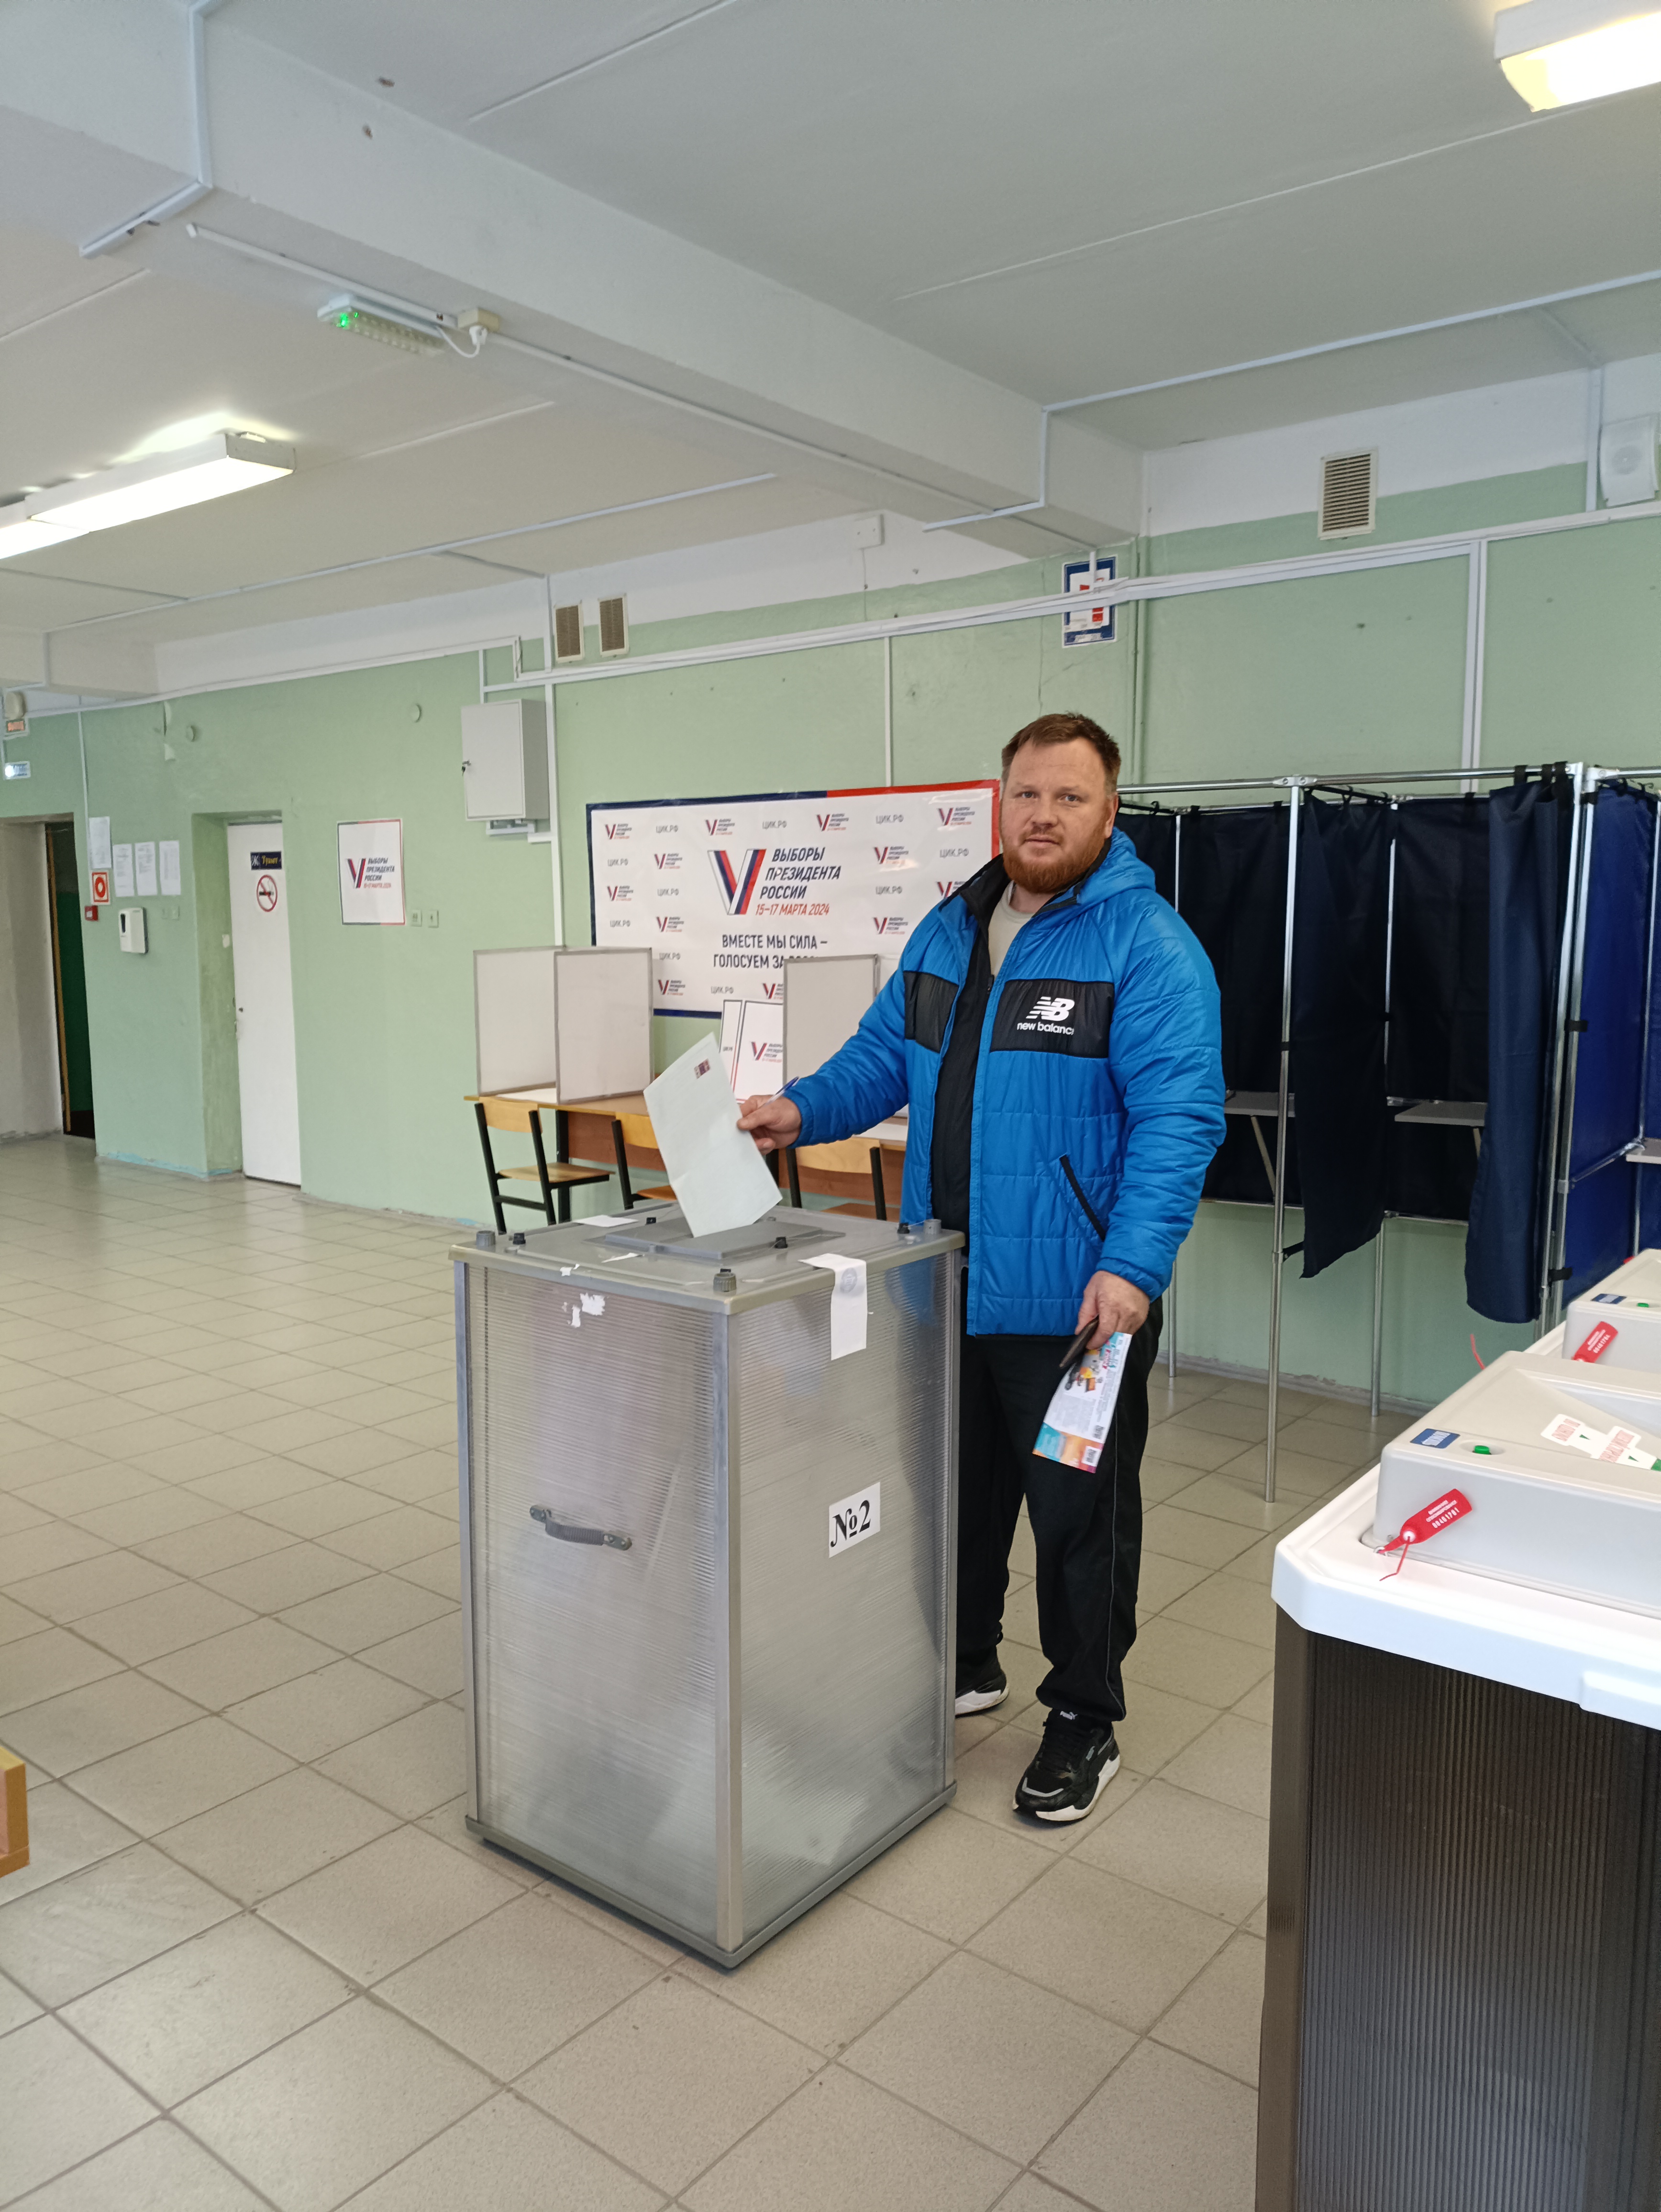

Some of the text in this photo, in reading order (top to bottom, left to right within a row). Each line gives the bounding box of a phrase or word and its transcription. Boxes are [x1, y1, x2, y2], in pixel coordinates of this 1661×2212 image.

[876, 815, 904, 824] ЦИК.РФ
[772, 847, 825, 862] ВЫБОРЫ
[940, 849, 969, 858] ЦИК.РФ
[765, 866, 841, 882] ПРЕЗИДЕНТА
[760, 885, 807, 899] РОССИИ
[876, 886, 902, 895] ЦИК.РФ
[779, 903, 807, 916] МАРТА
[808, 903, 830, 916] 2024
[722, 934, 763, 948] ВМЕСТЕ
[767, 935, 786, 949] МЫ
[790, 935, 817, 949] СИЛА
[714, 954, 769, 968] ГОЛОСУЕМ
[1017, 1022, 1036, 1030] new
